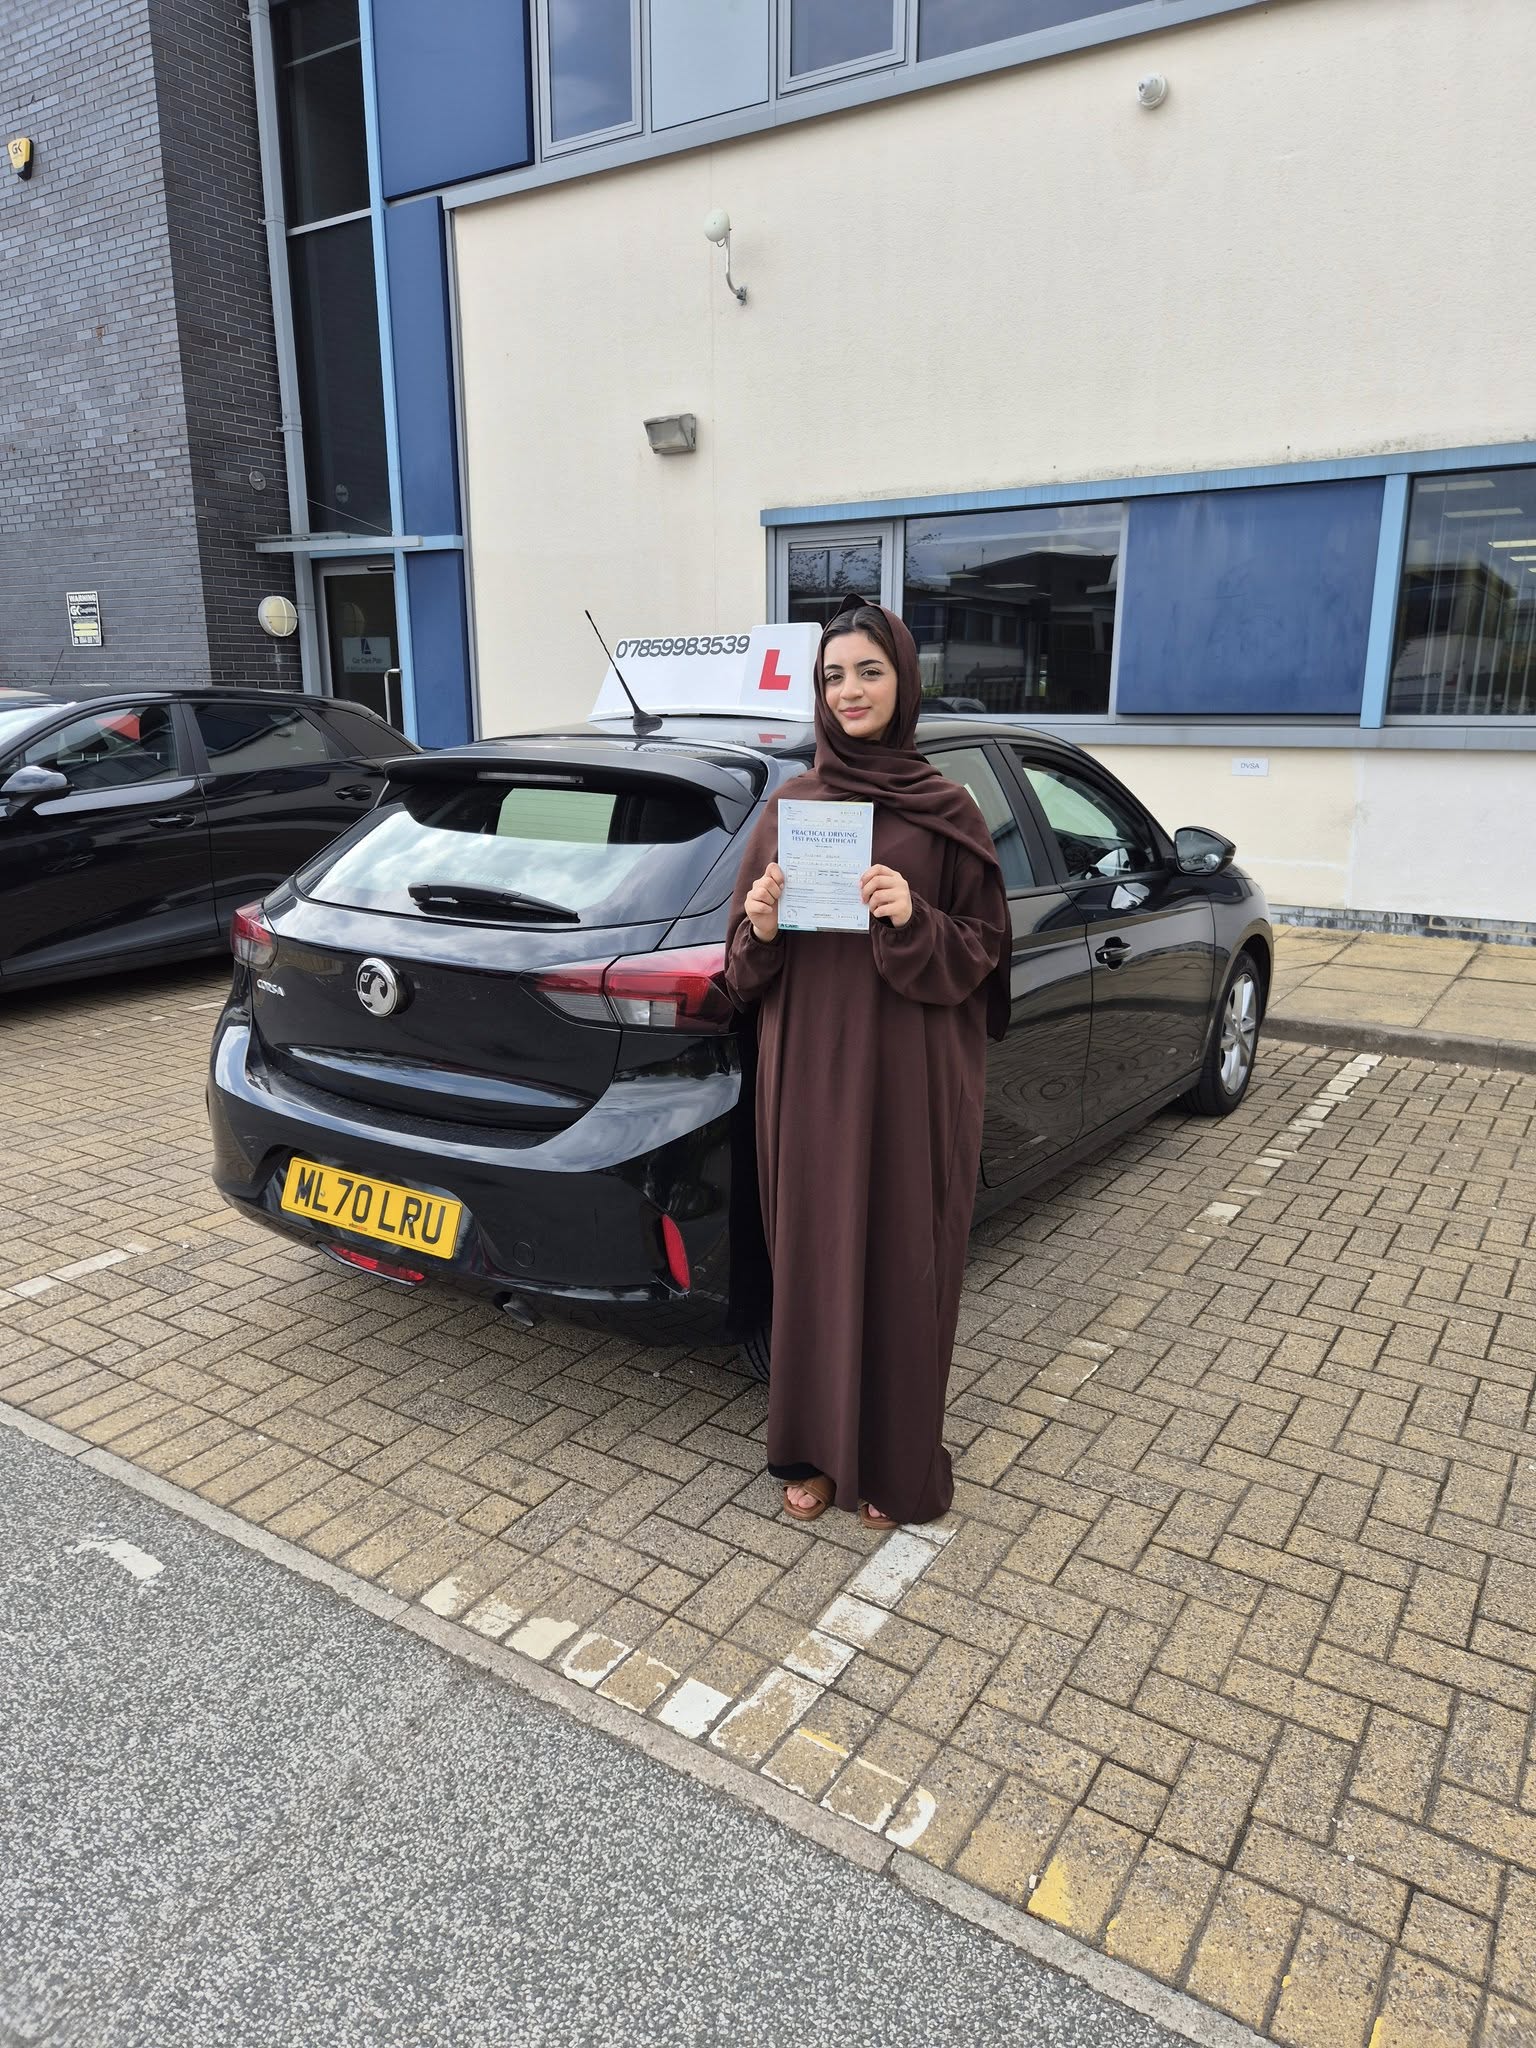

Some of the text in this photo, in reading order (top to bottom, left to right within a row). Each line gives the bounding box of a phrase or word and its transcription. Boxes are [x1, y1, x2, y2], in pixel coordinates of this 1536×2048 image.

[12, 141, 22, 154] GK
[69, 594, 96, 602] WARNING
[615, 635, 750, 659] 07859983539
[758, 649, 791, 690] L
[791, 829, 826, 837] PRACTICAL
[821, 837, 857, 845] CERTIFICATE
[256, 978, 286, 997] CORSA
[294, 1166, 446, 1245] ML70 LRU
